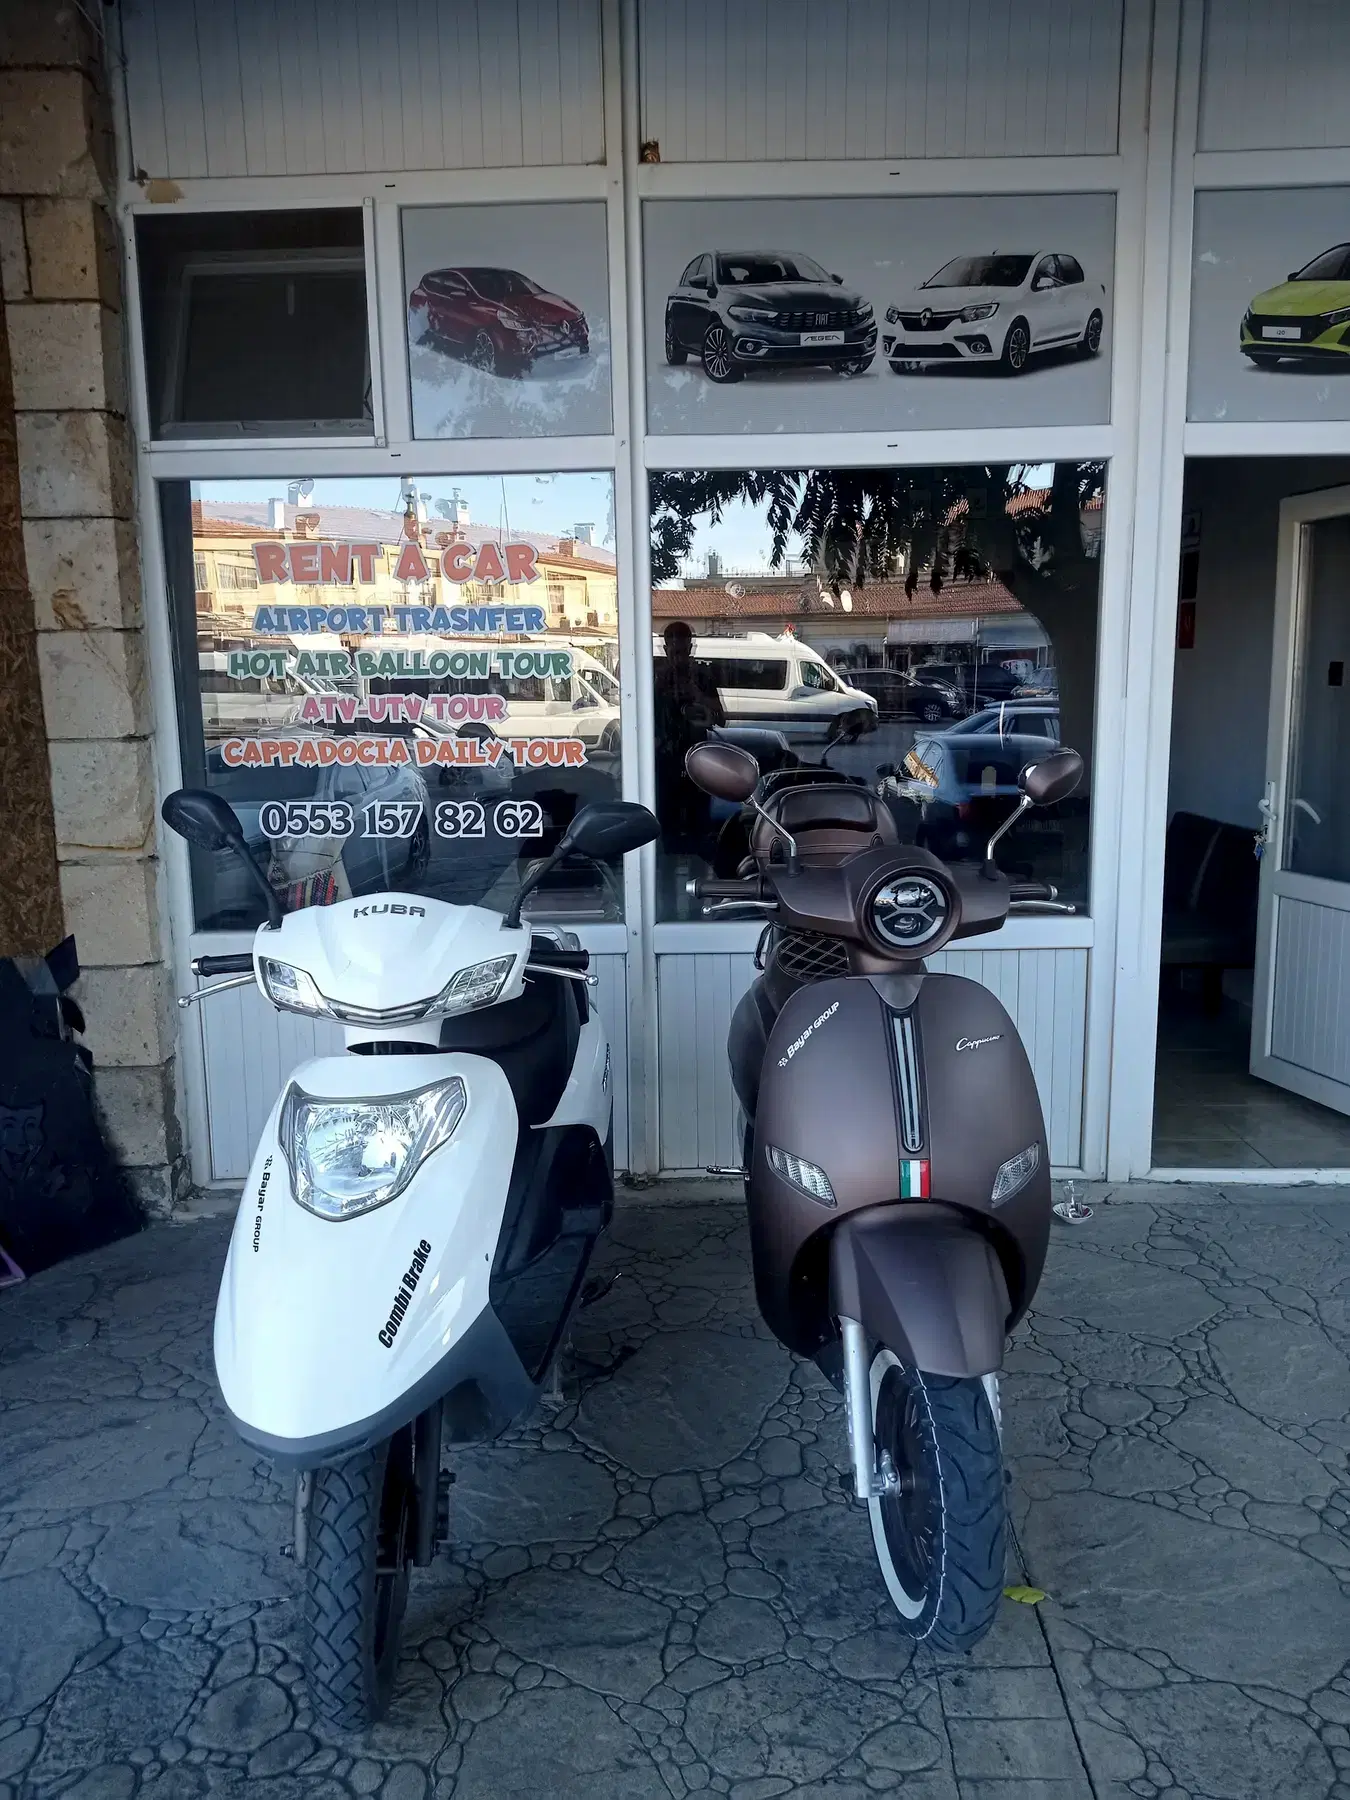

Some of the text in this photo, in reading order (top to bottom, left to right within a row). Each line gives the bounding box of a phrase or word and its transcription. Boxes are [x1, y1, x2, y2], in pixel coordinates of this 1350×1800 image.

[815, 313, 829, 326] FIAT
[252, 541, 541, 584] RENT A CAR
[253, 605, 548, 635] AIRPORT TRASNFER
[227, 649, 575, 680] HOT AIR BALLOON TOUR
[301, 694, 510, 724] ATV-UTV TOUR
[221, 738, 588, 768] CAPPADOCIA DAILY TOUR
[259, 800, 543, 838] 0553 157 82 62
[353, 904, 426, 918] KUBA
[787, 1001, 840, 1059] Bayar GROUP
[252, 1172, 271, 1253] Bayar GROUP
[378, 1239, 432, 1349] Combi Brake
